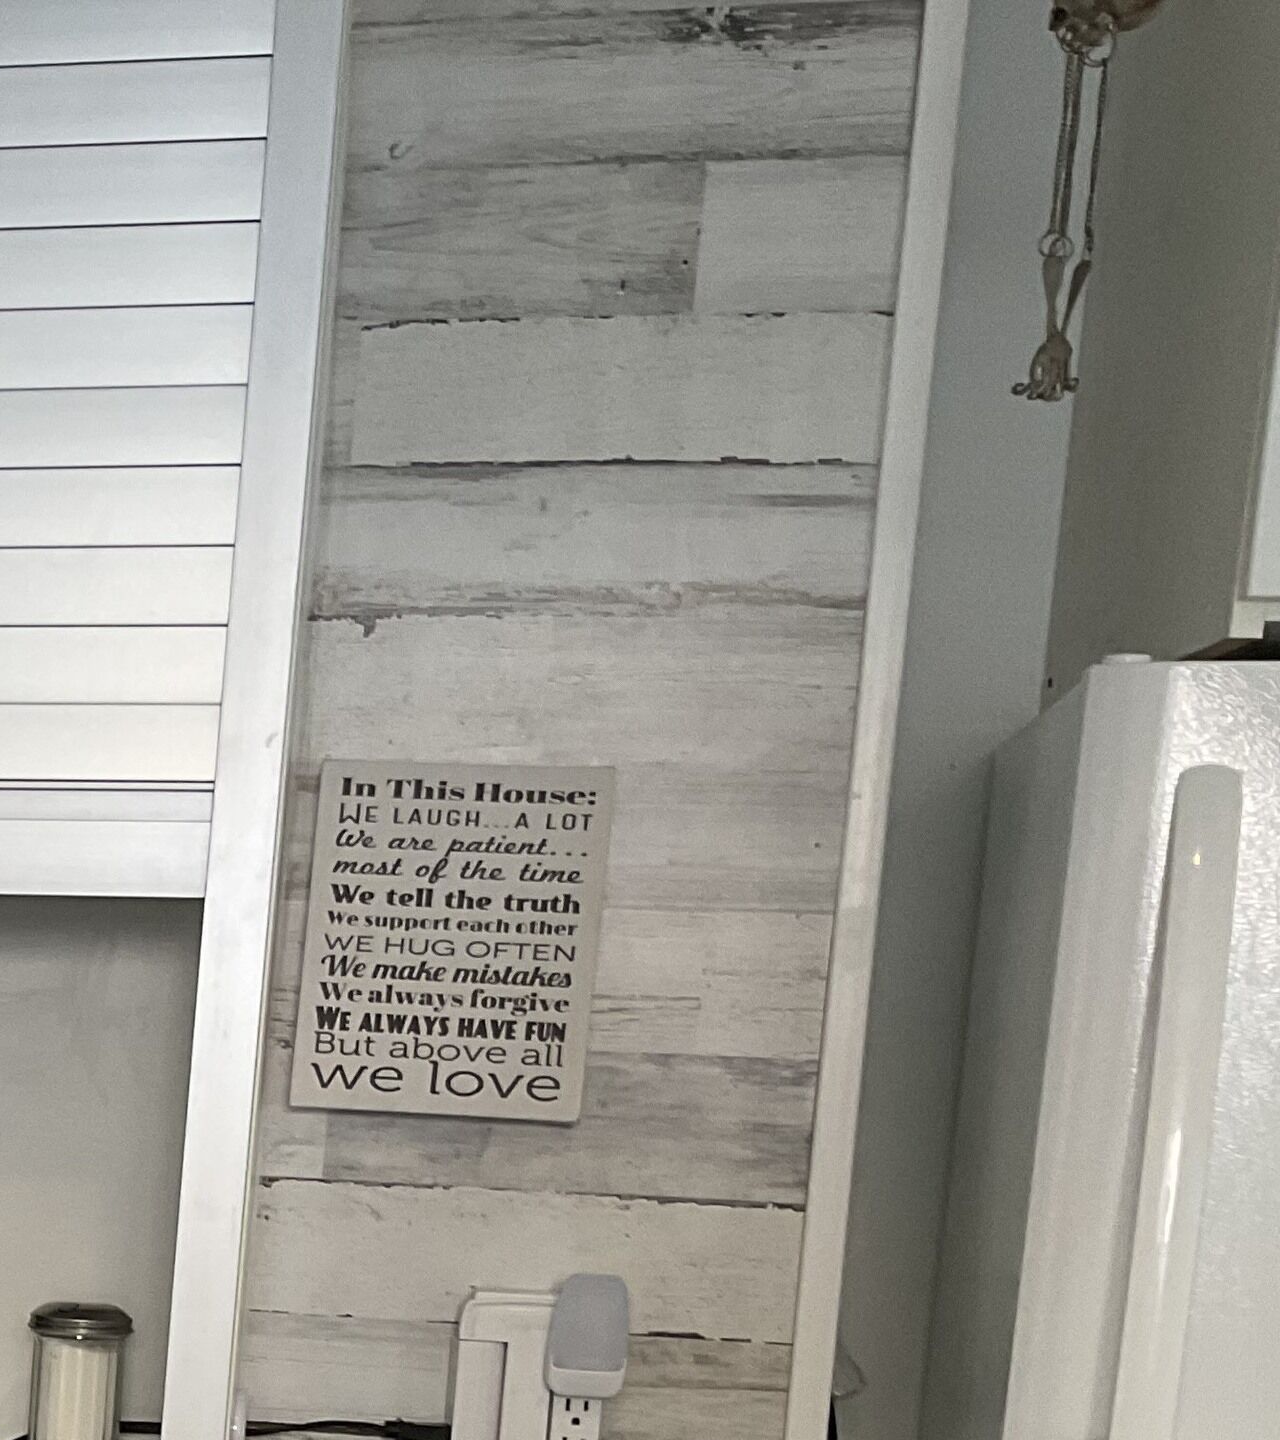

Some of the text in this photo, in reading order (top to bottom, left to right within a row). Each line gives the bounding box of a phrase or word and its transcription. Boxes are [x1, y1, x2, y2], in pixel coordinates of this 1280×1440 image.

[341, 777, 598, 805] In This House:
[339, 803, 379, 825] WE
[546, 813, 594, 831] LOT
[336, 829, 589, 858] We are patient...
[332, 857, 584, 884] most of the time
[331, 883, 581, 915] We tell the truth
[329, 911, 578, 937] We support each other
[325, 933, 576, 962] WE HUG OFTEN
[321, 955, 572, 988] We make mistakes
[320, 982, 571, 1015] We always forgive
[316, 1006, 566, 1042] WE ALWAYS HAVE FUN
[314, 1031, 564, 1067] But above all
[311, 1060, 562, 1102] we love
